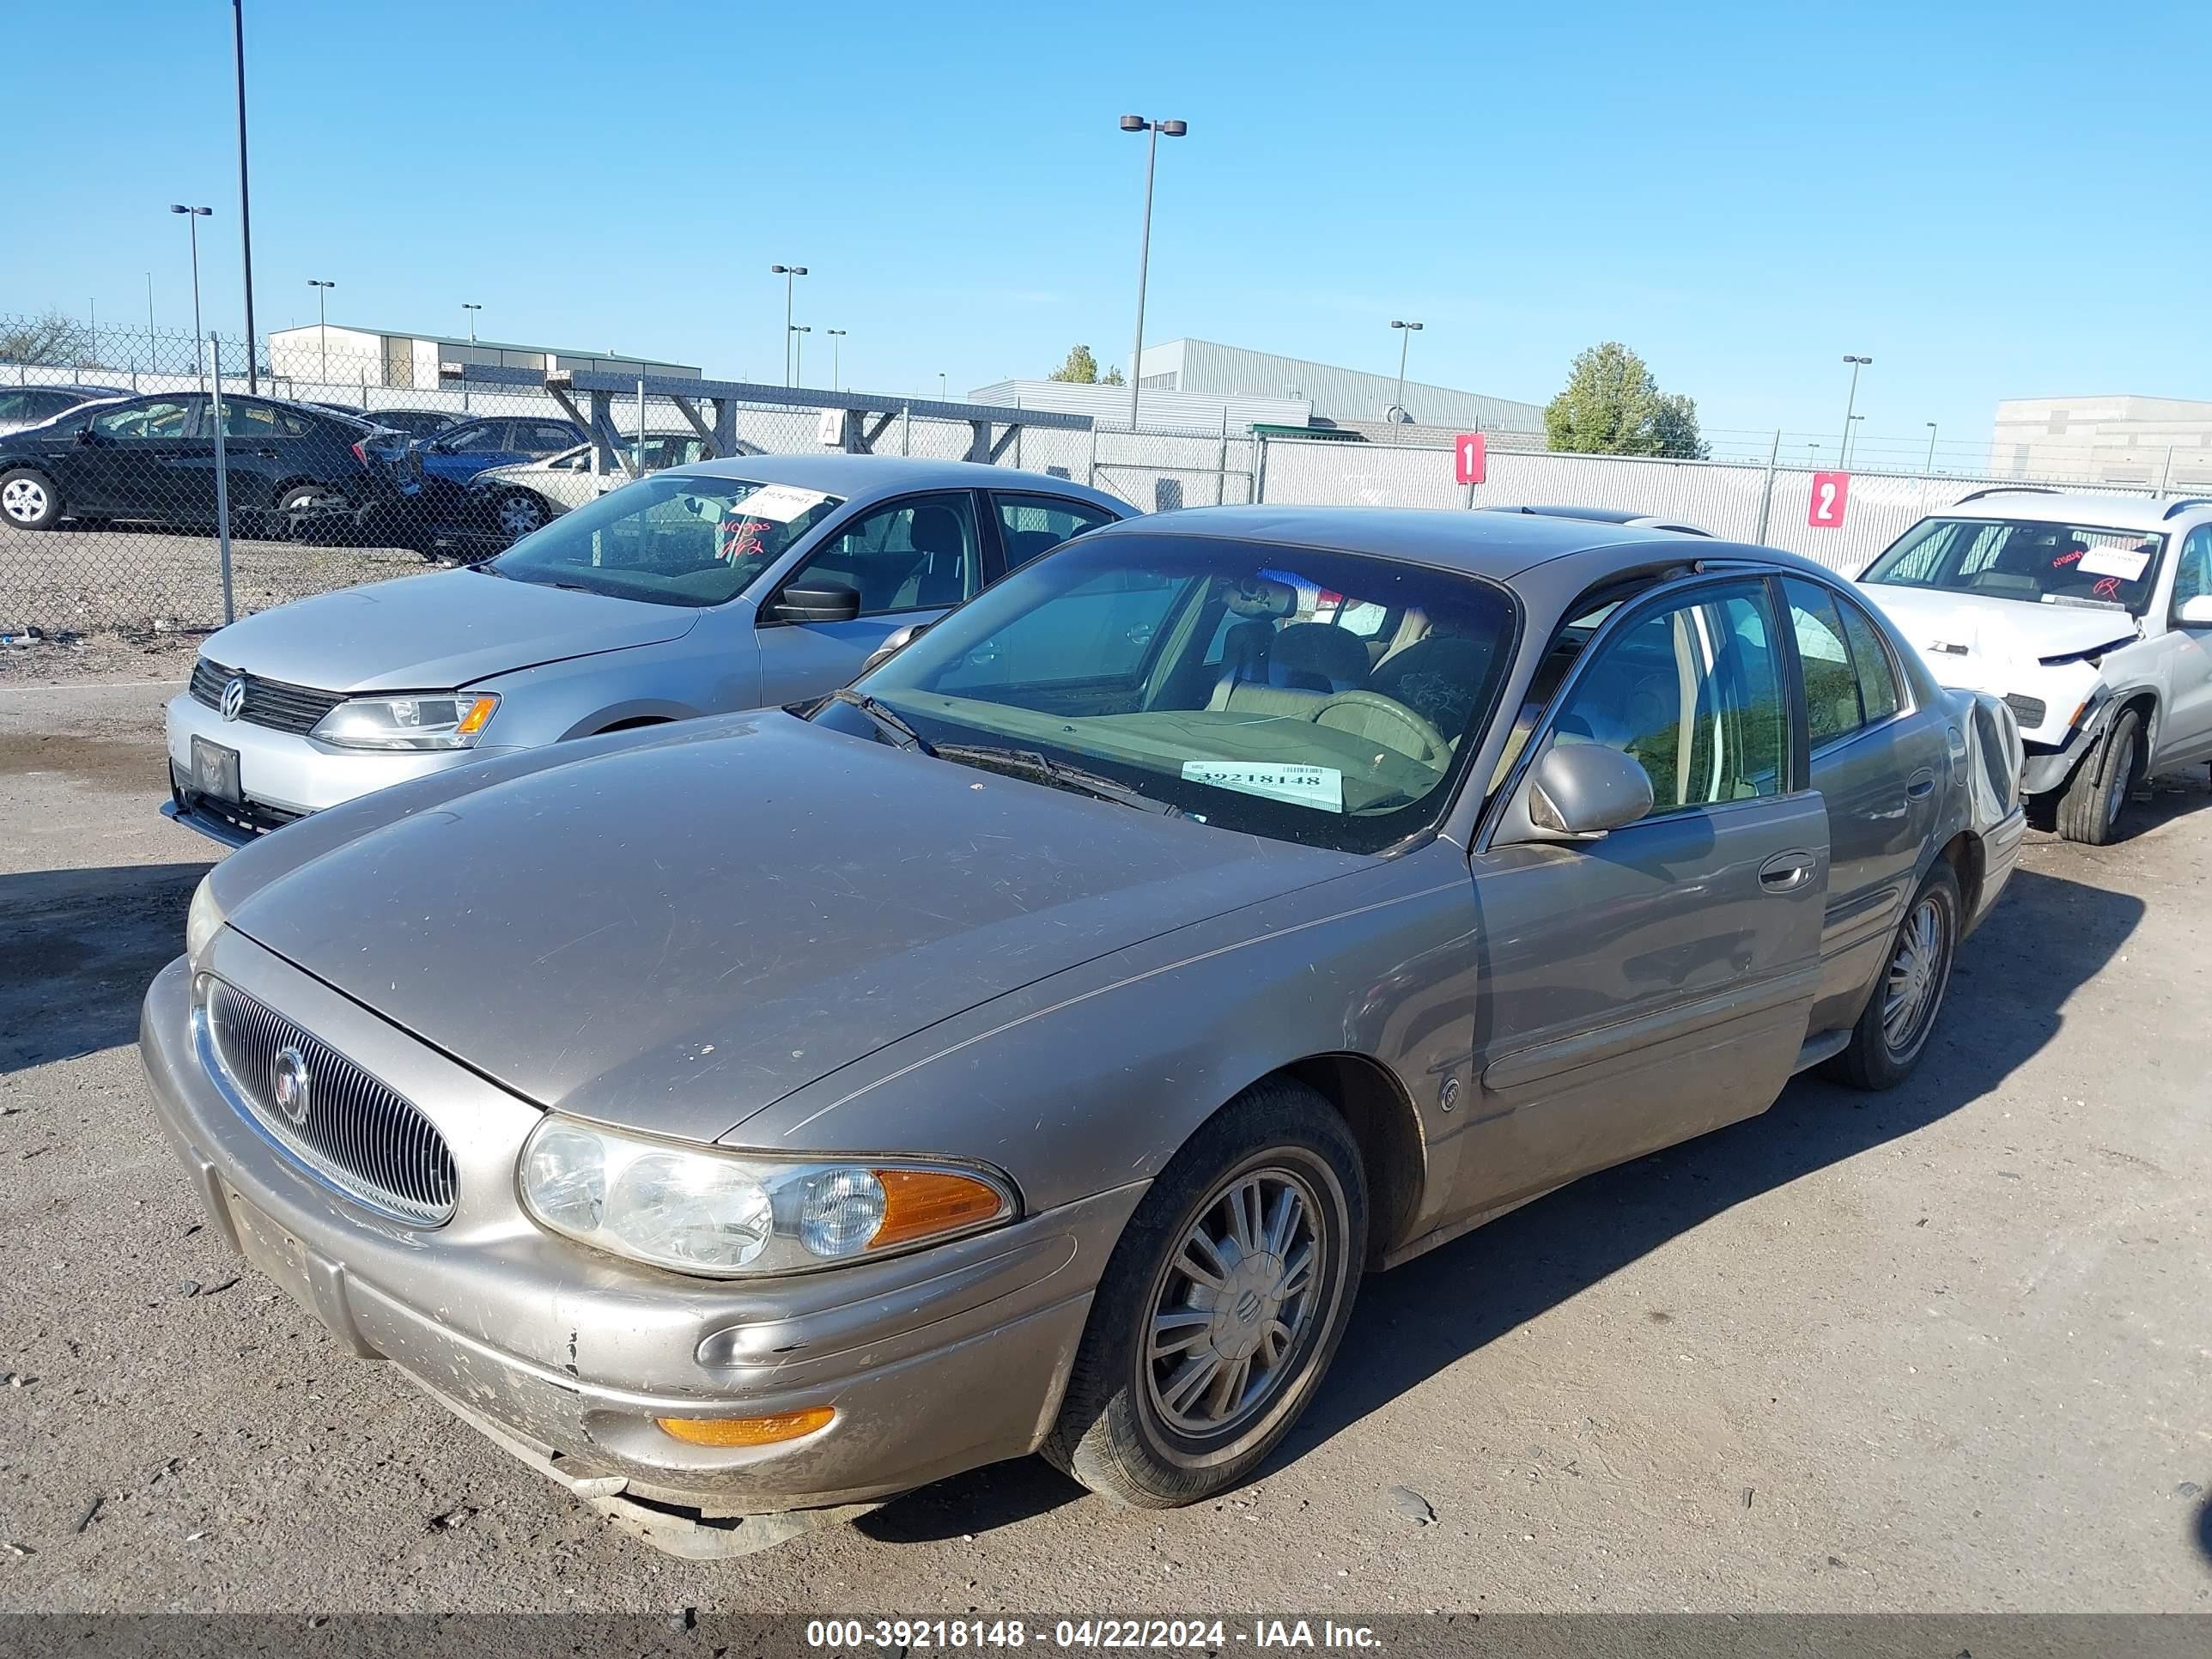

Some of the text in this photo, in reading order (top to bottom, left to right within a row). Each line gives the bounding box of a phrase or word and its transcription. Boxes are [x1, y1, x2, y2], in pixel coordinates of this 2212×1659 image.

[823, 415, 835, 439] A
[1463, 443, 1474, 476] 1
[1818, 483, 1837, 520] 2
[1198, 773, 1321, 786] 39218148
